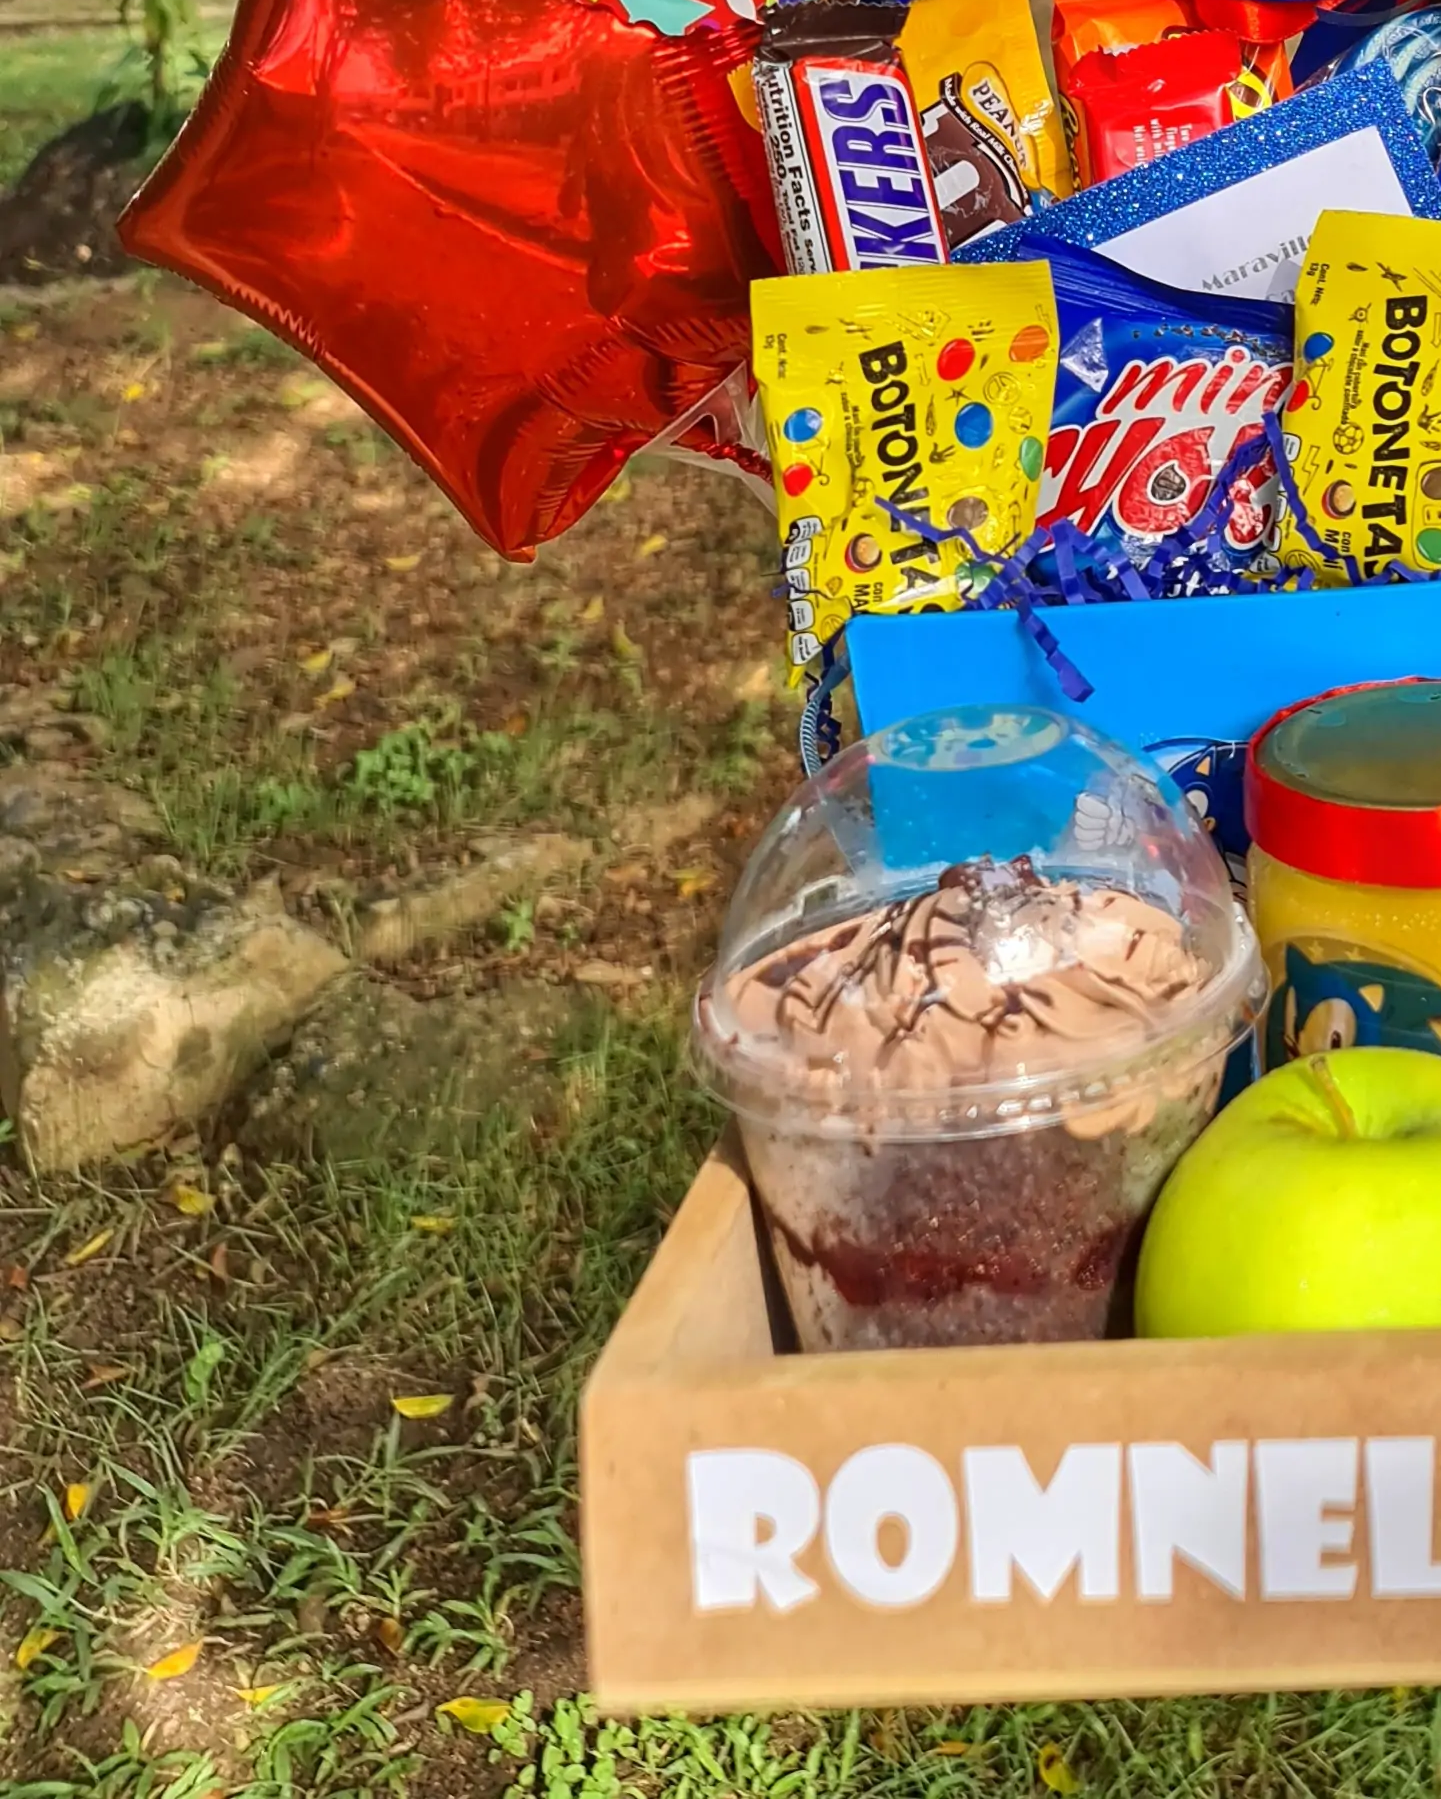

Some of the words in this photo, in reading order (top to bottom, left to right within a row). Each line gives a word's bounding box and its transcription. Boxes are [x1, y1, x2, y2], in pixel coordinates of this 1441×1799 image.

[971, 81, 1027, 168] PEANUT
[1153, 142, 1165, 159] mil
[788, 166, 811, 232] Facts
[819, 78, 941, 270] KERS
[1201, 234, 1312, 291] Maravill
[1102, 348, 1294, 415] min
[858, 340, 944, 613] BOTONTA
[1341, 531, 1352, 553] con
[854, 584, 871, 614] MA
[873, 582, 884, 602] con
